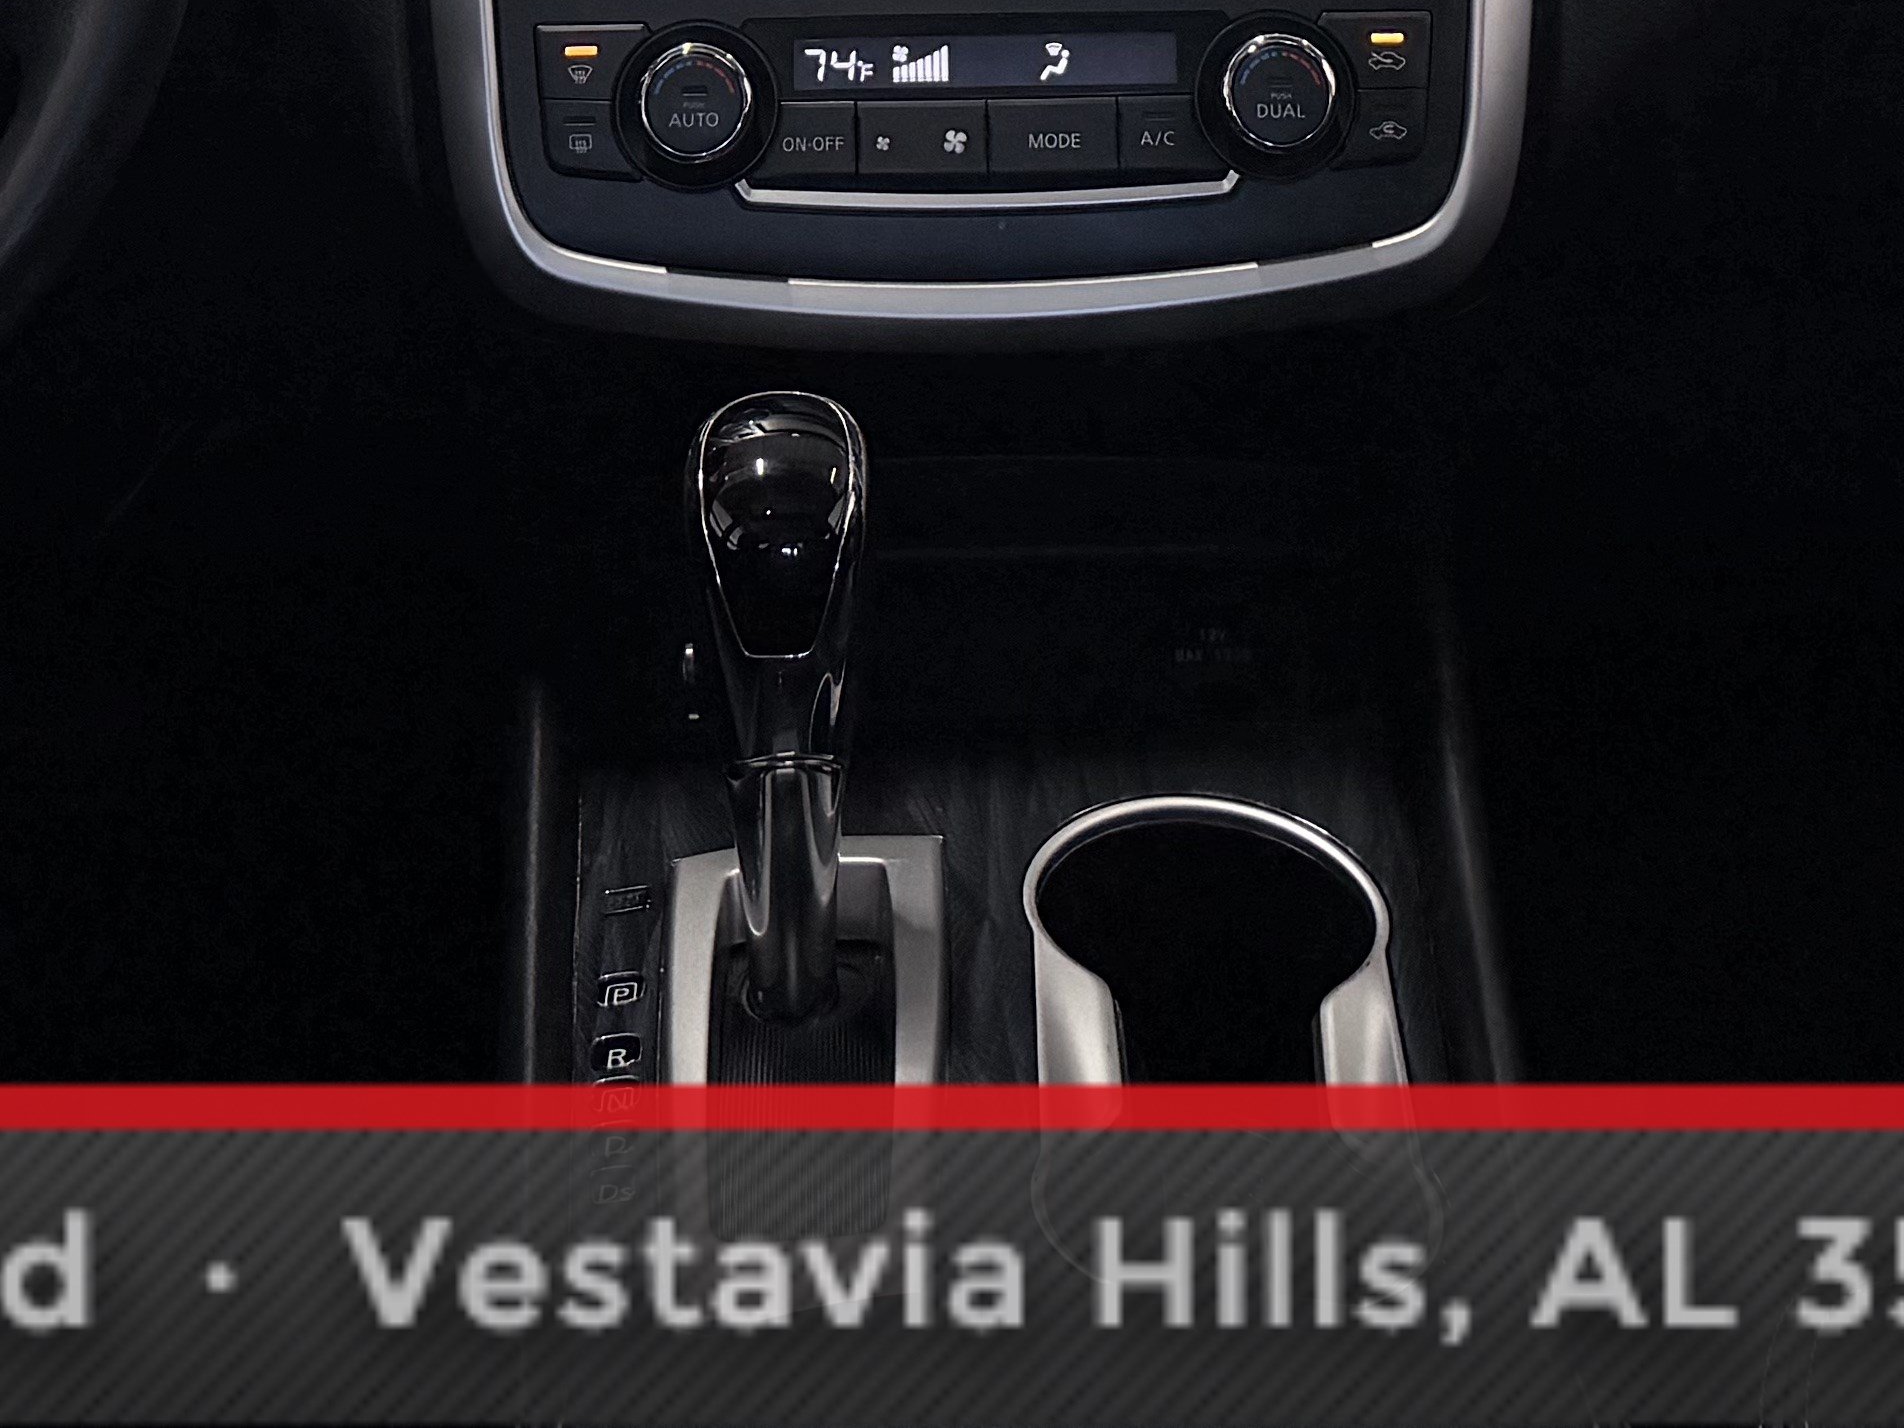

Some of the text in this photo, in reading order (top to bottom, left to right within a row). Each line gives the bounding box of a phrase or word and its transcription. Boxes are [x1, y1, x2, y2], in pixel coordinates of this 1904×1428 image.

[1256, 103, 1306, 119] DUAL
[668, 112, 720, 128] AUTO
[1027, 132, 1082, 150] MODE
[1139, 130, 1176, 147] A/C
[606, 1047, 628, 1068] R
